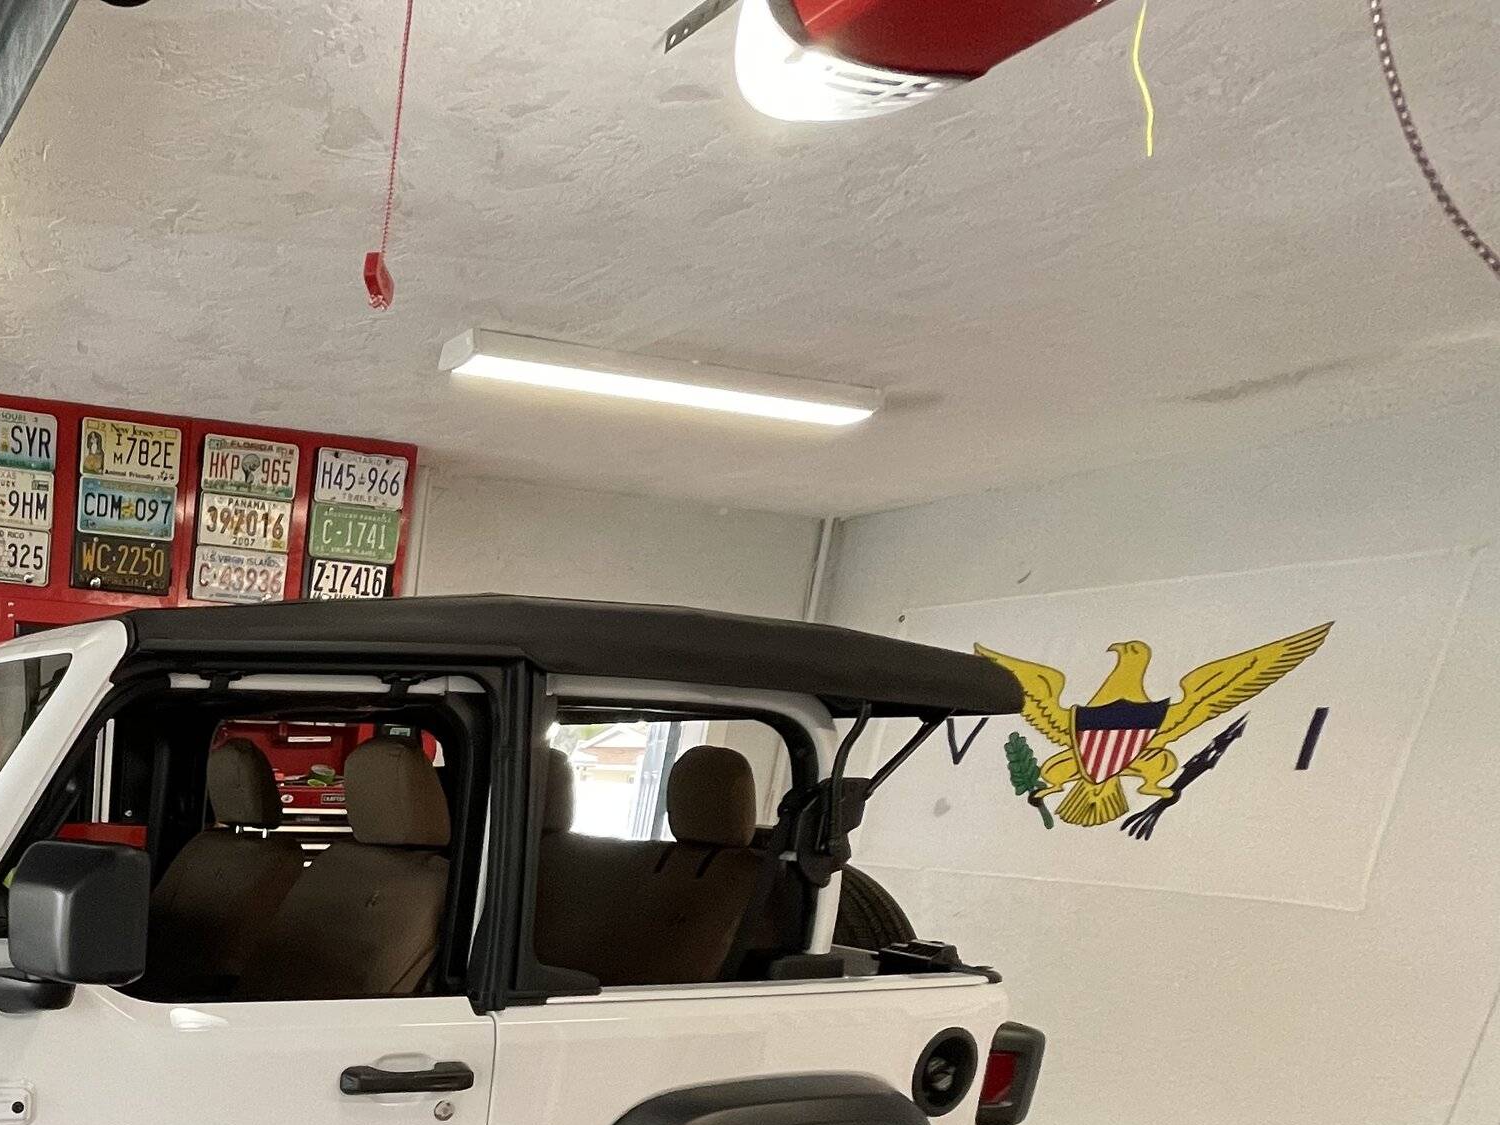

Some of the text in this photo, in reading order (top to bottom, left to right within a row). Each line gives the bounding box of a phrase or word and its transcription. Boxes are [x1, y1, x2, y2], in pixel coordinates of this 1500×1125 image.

[10, 425, 51, 458] SYR
[110, 422, 154, 438] New Jersey
[126, 437, 175, 470] 782E
[230, 441, 274, 452] FLORIDA
[209, 451, 291, 487] HKP 965
[321, 461, 400, 496] H45 966
[8, 490, 48, 520] 9HM
[84, 492, 172, 525] CDM 097
[228, 498, 266, 511] PANAMA
[7, 531, 25, 540] RICO
[206, 506, 285, 541] 397016
[322, 519, 387, 550] C-1741
[7, 543, 43, 570] 325
[232, 537, 255, 547] 2007
